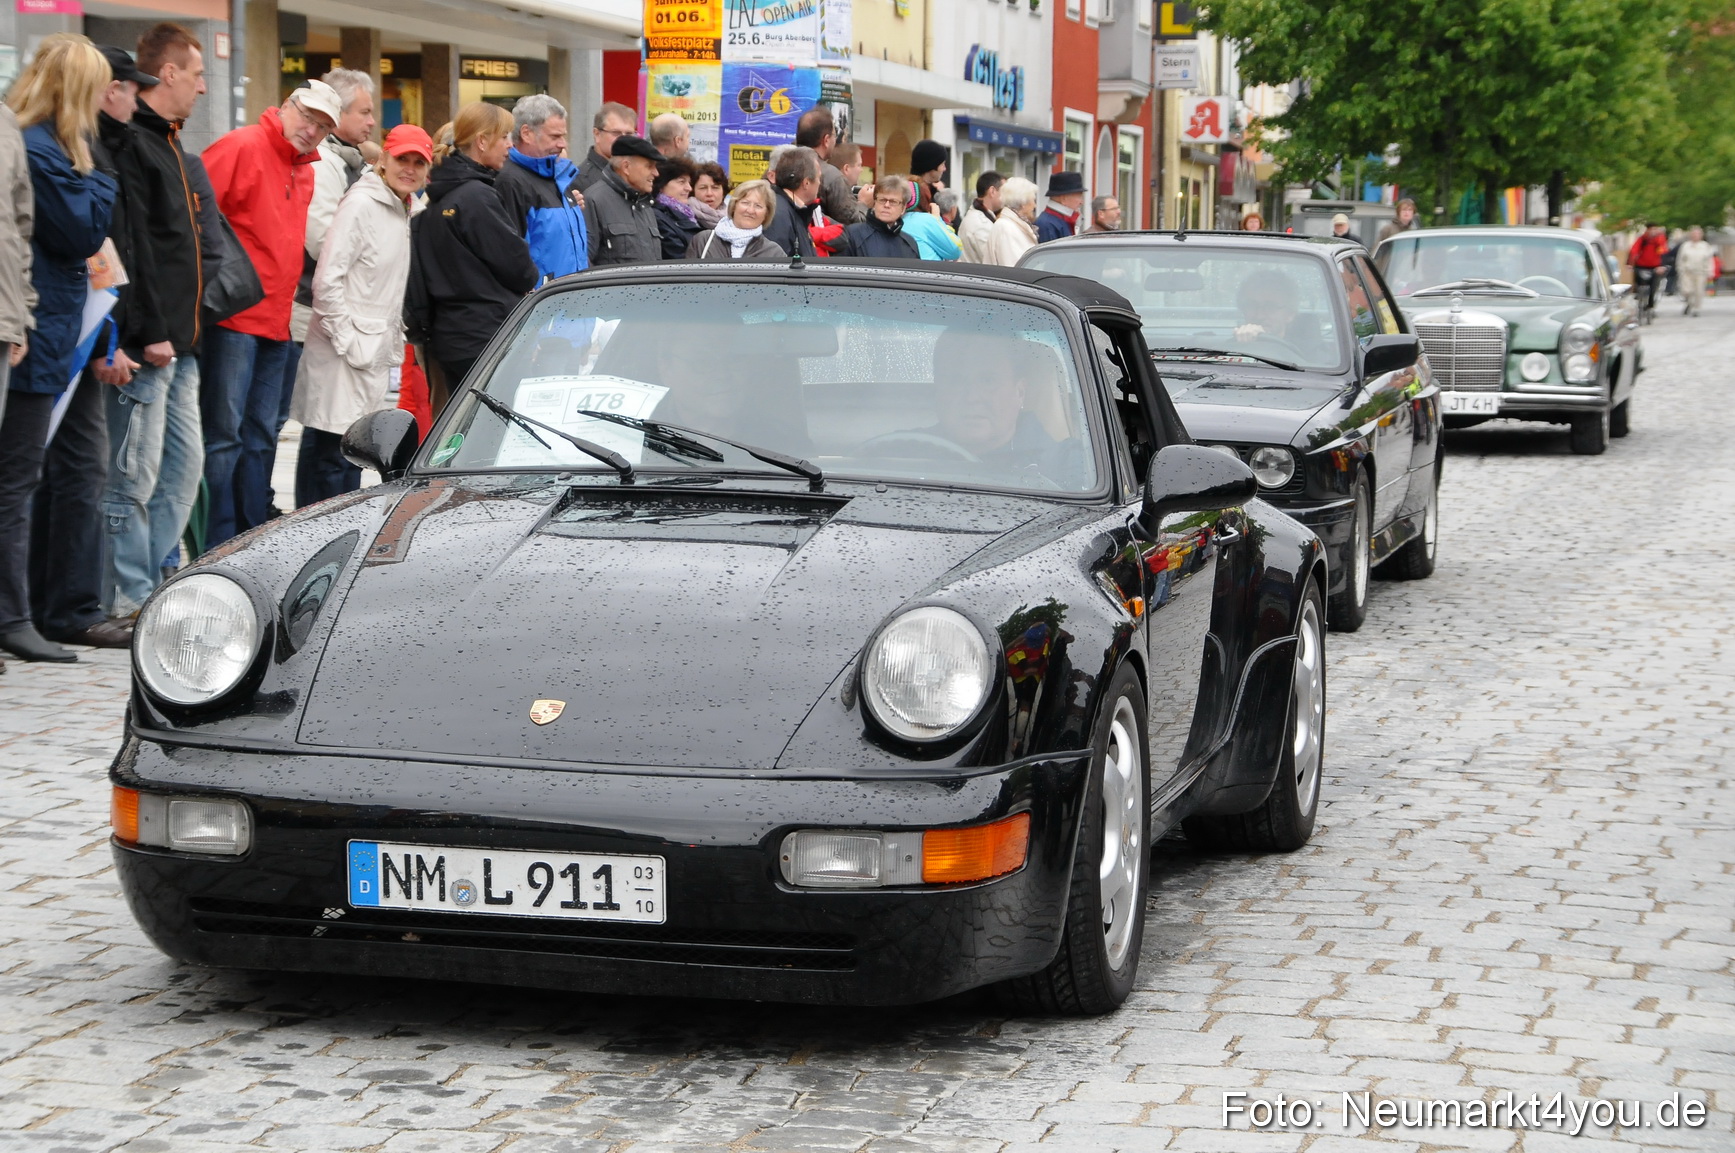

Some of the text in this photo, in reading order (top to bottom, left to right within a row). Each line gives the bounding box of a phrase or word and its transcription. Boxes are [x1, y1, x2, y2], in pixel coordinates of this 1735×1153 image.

[656, 10, 705, 24] 01.06.
[763, 3, 795, 25] OPEN
[648, 37, 714, 50] Volksfestplatz
[728, 32, 765, 45] 25.6.
[765, 33, 782, 41] Burg
[462, 59, 520, 77] FRIES
[1162, 58, 1190, 66] Stern
[697, 112, 717, 121] 2013
[733, 150, 764, 160] Metal
[576, 392, 626, 411] 478
[1451, 398, 1468, 410] JT
[634, 866, 654, 880] 03
[360, 880, 370, 893] D
[382, 852, 621, 911] NM L 911
[635, 899, 654, 914] 10
